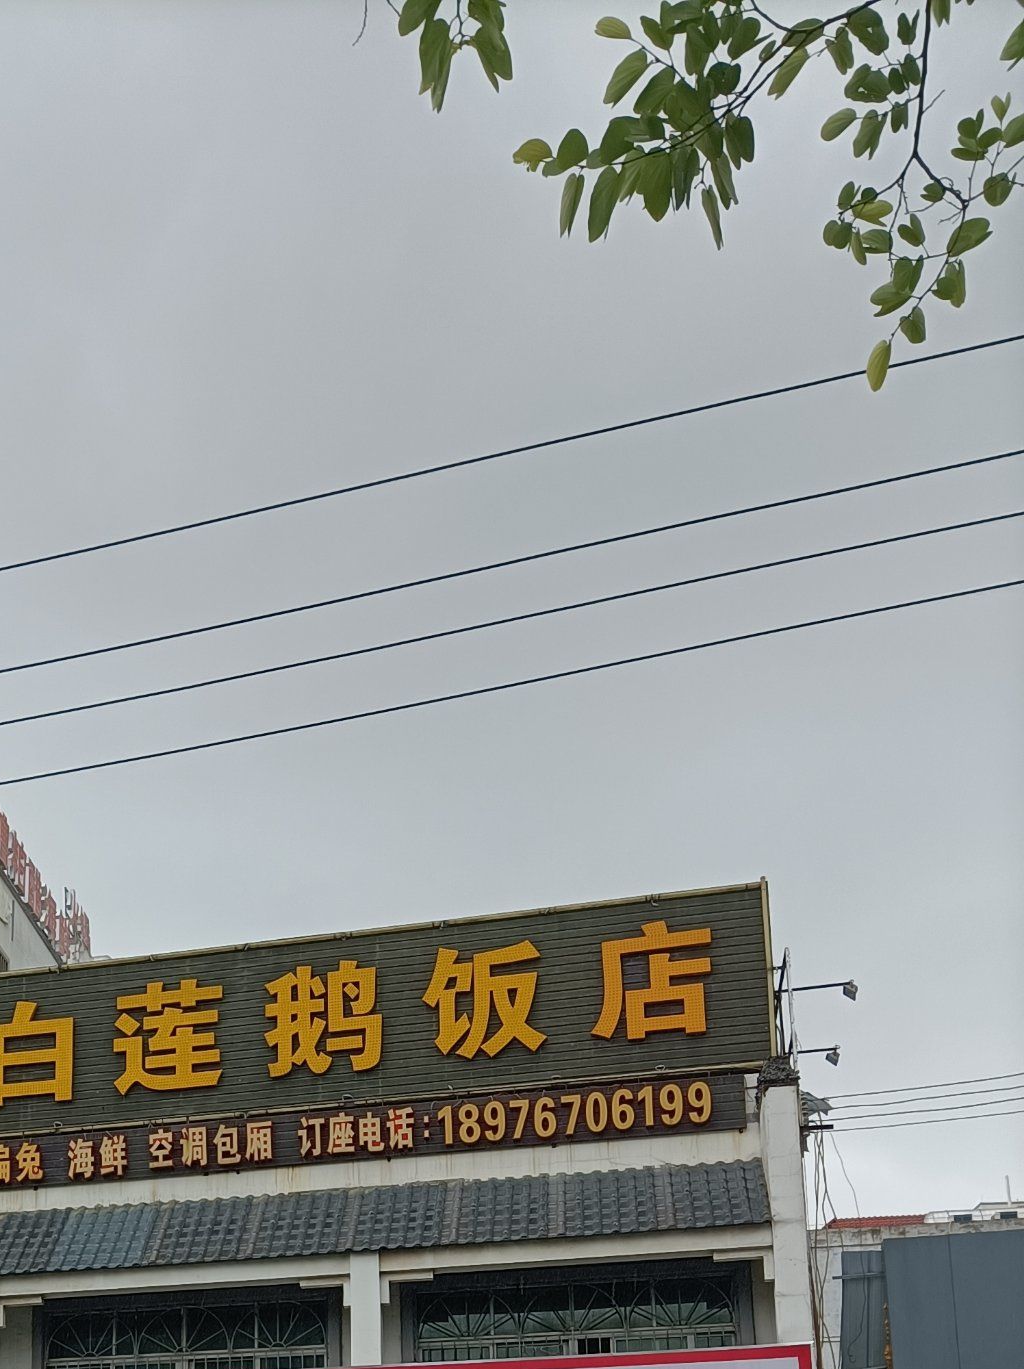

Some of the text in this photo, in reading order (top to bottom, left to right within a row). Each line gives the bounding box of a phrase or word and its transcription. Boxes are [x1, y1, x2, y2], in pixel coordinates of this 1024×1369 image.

[68, 1133, 128, 1180] 海鲜
[148, 1120, 273, 1169] 空调包厢
